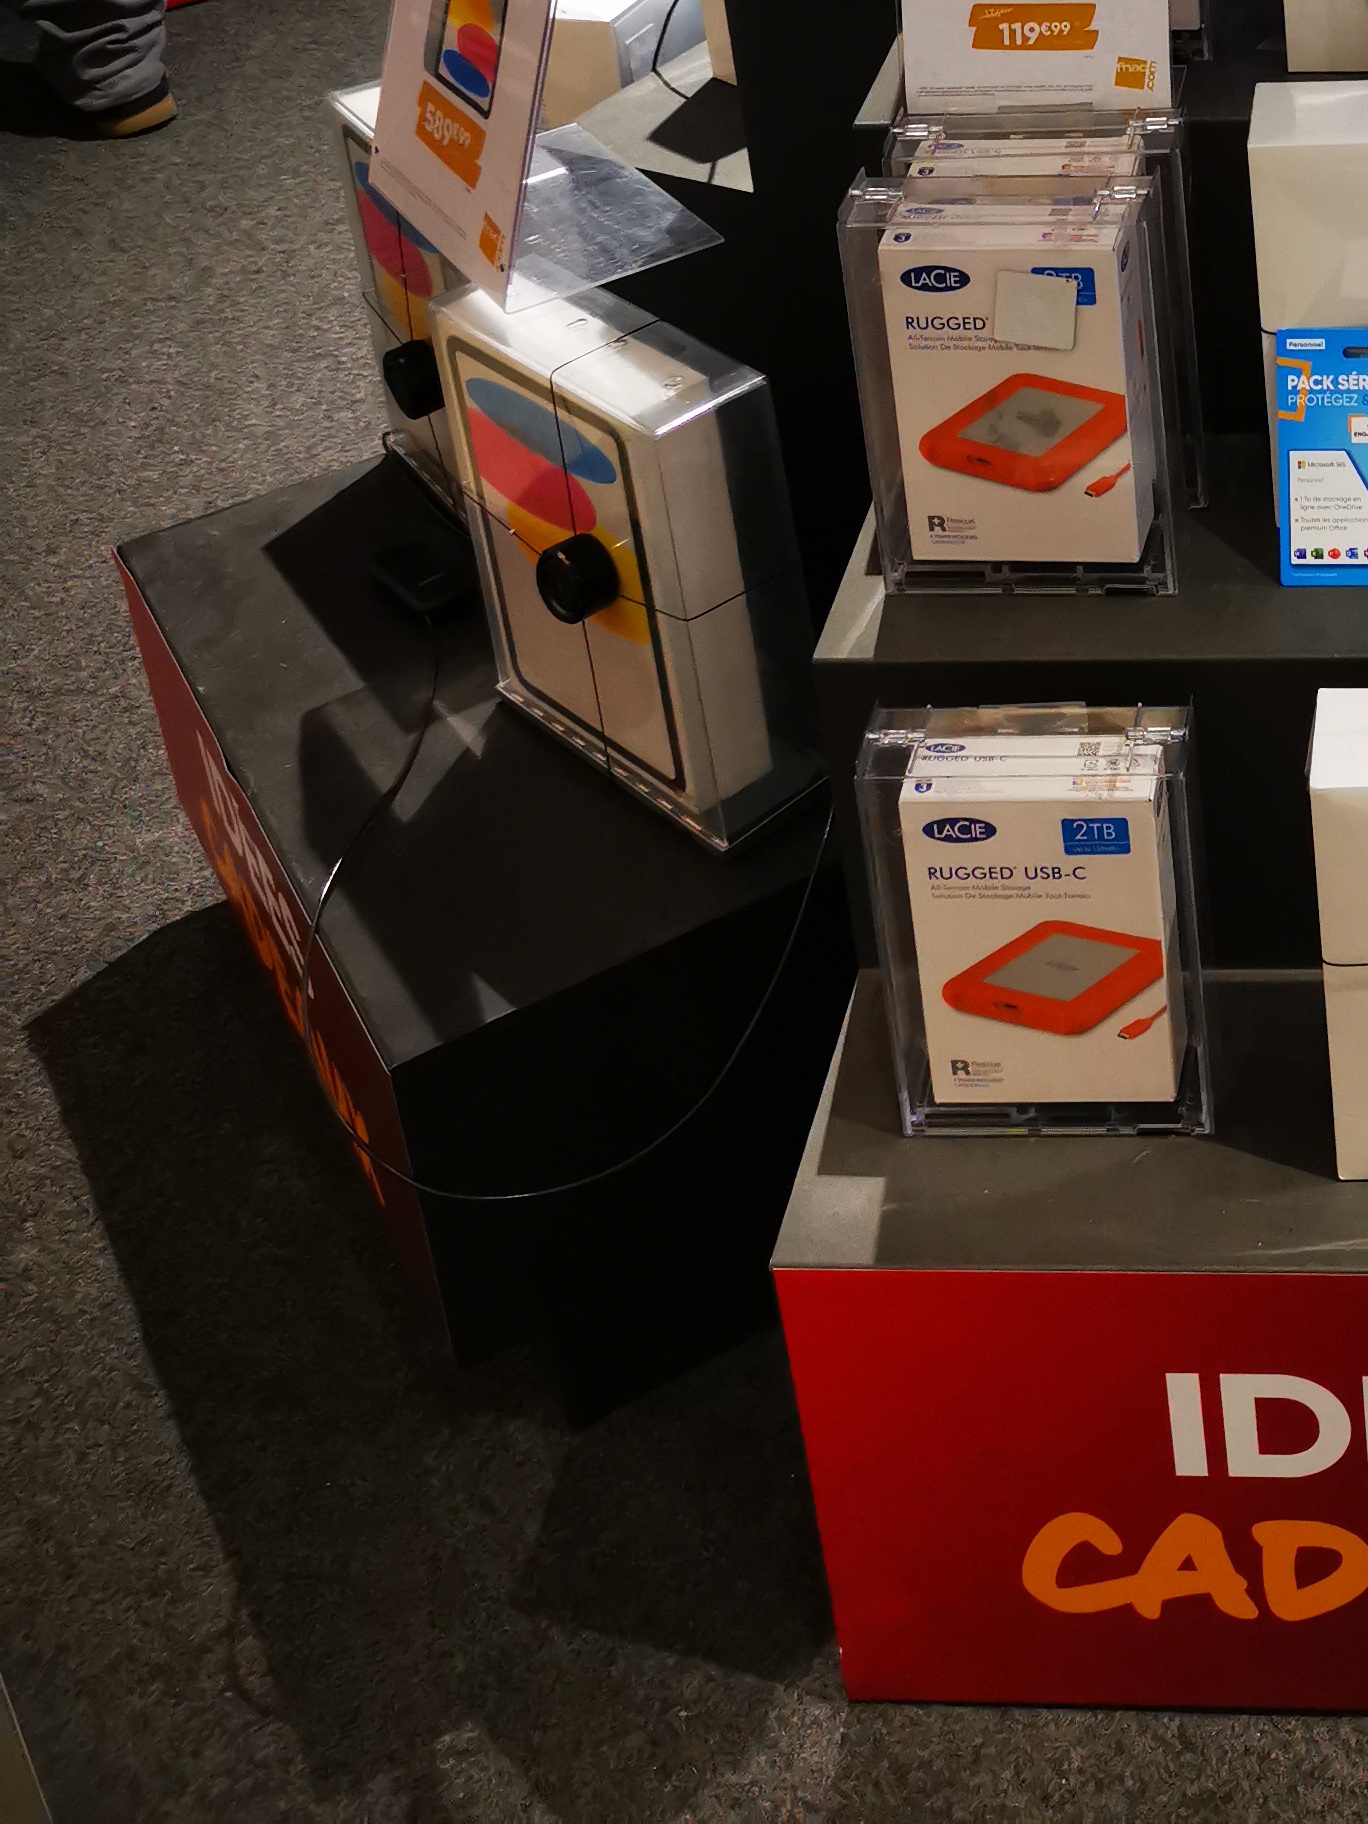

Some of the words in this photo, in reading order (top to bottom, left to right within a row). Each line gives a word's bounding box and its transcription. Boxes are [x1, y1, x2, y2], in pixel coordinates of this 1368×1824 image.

[999, 22, 1070, 45] 119€99
[911, 270, 961, 288] LACIE
[1288, 375, 1336, 390] PACK
[933, 821, 986, 838] LACIE
[1073, 821, 1116, 840] 2TB
[1024, 866, 1087, 880] USB-C
